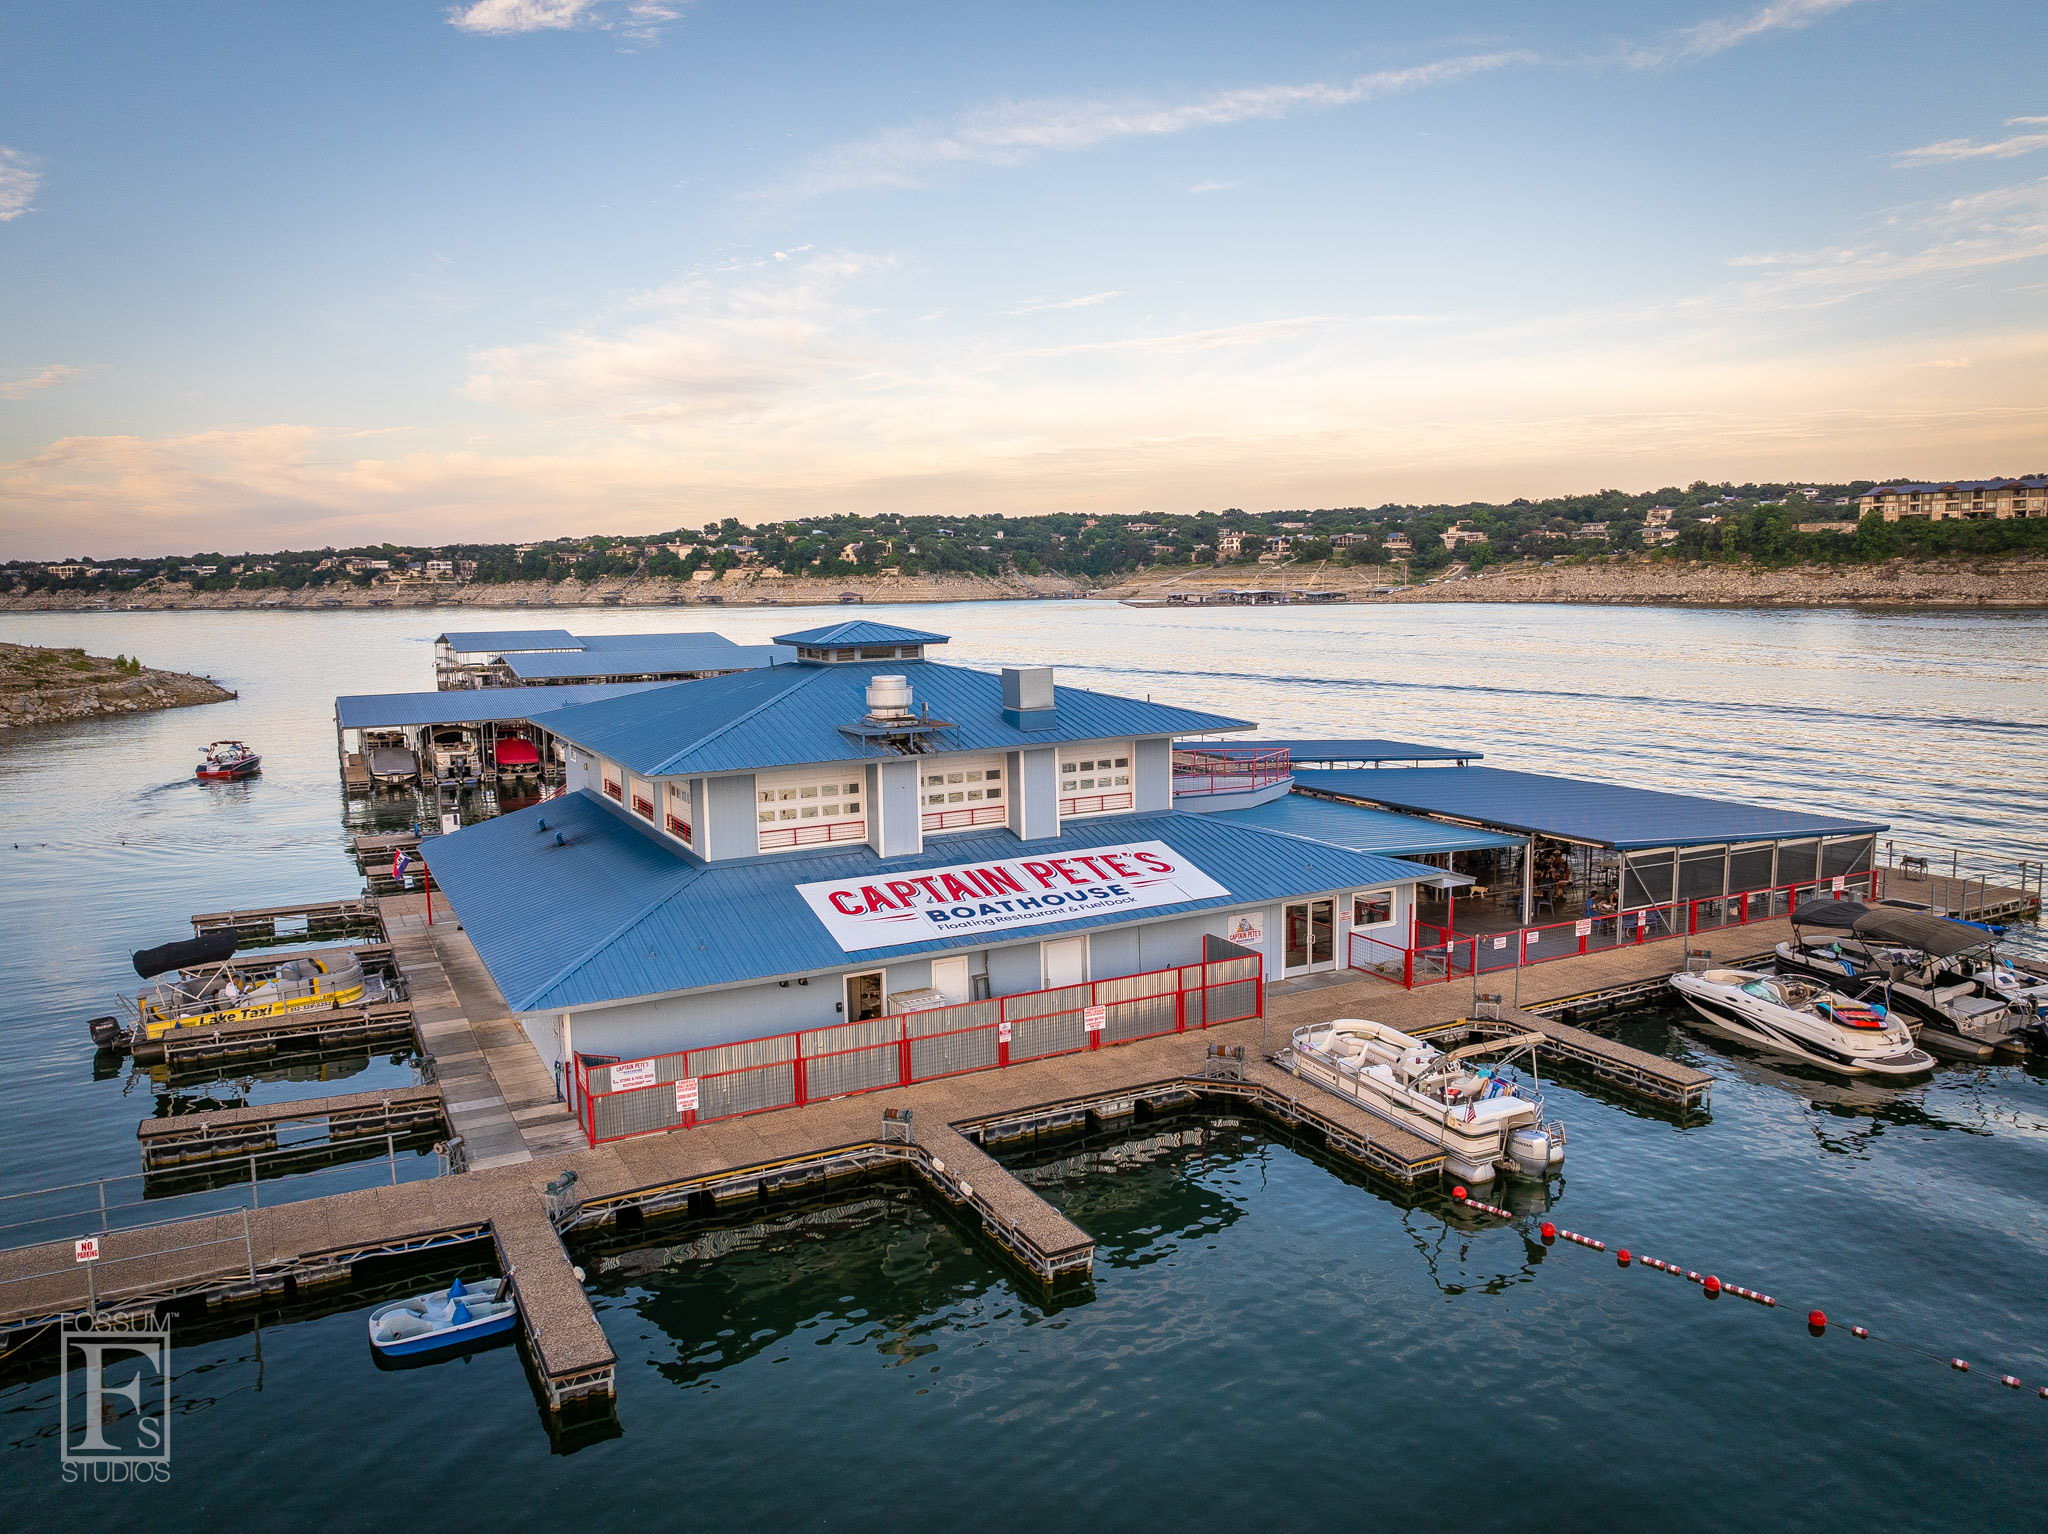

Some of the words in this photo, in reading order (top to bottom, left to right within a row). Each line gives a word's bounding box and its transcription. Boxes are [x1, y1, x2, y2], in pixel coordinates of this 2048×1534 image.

[828, 866, 1030, 916] CAPTAIN
[1020, 852, 1175, 889] PETE'S
[925, 884, 1131, 922] BOATHOUSE
[937, 918, 996, 931] Floating
[995, 907, 1065, 923] Restaurant
[199, 1013, 237, 1025] Lake
[240, 1004, 273, 1019] Taxi
[77, 1250, 98, 1259] PARKING
[81, 1242, 93, 1251] NO
